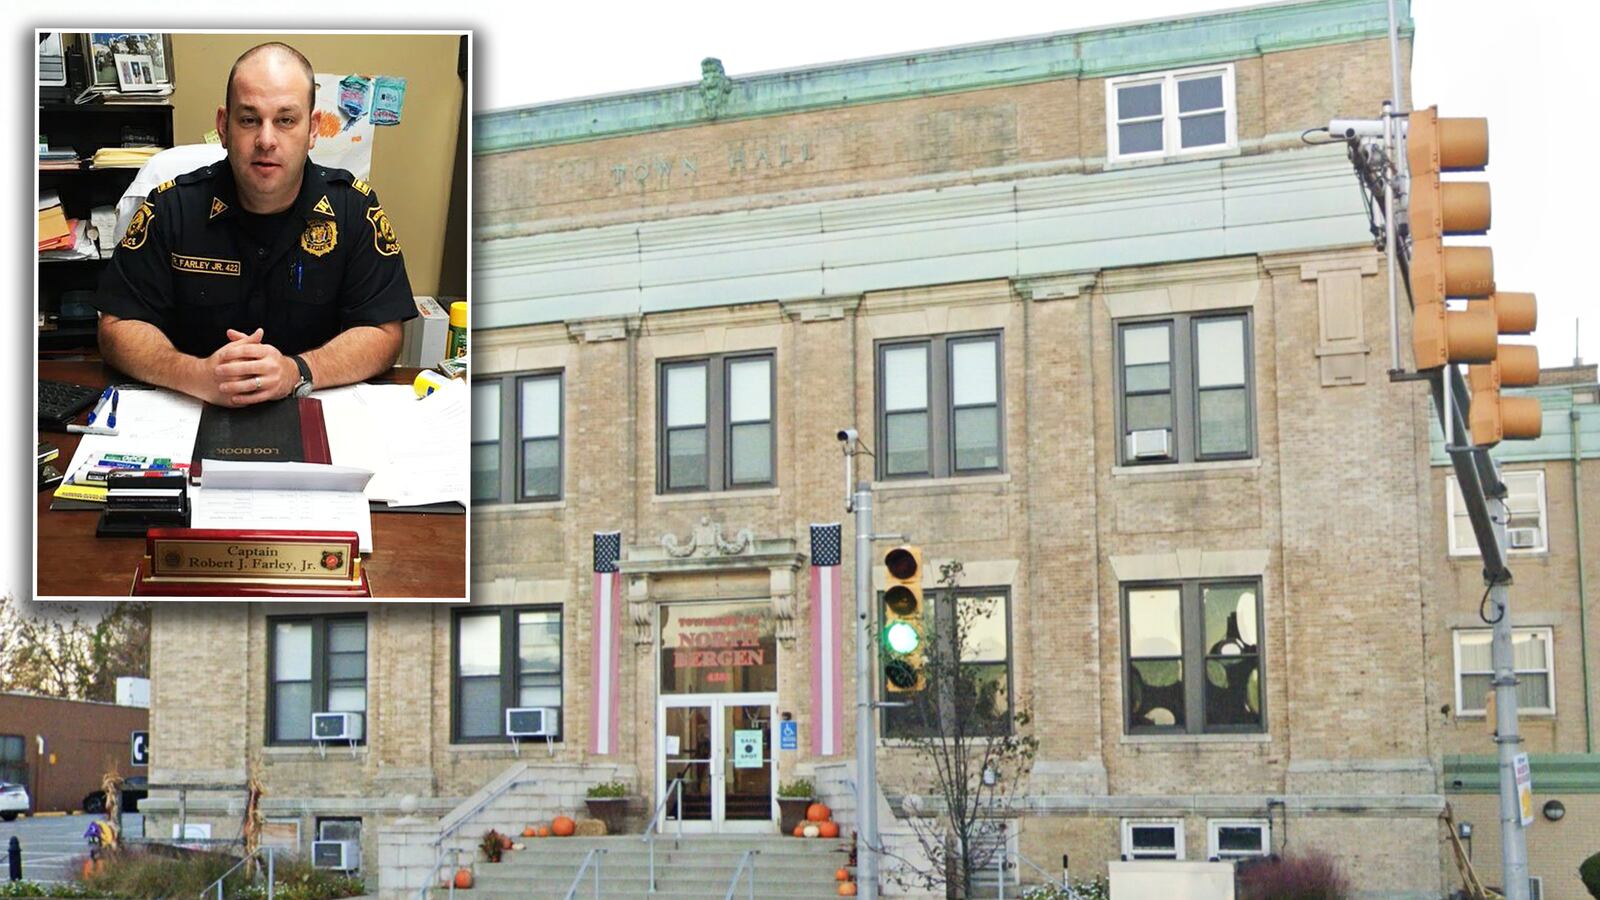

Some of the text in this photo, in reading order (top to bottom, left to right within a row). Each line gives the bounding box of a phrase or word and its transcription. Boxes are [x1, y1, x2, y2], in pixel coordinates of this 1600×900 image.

[611, 140, 815, 186] TOWN HALL
[179, 258, 210, 270] FARLEY
[211, 262, 224, 271] JR.
[225, 264, 239, 273] 422
[227, 545, 278, 559] Captain
[188, 557, 317, 571] Robert J. Farley, Jr.
[678, 631, 760, 647] NORTH
[673, 650, 764, 667] BERGEN
